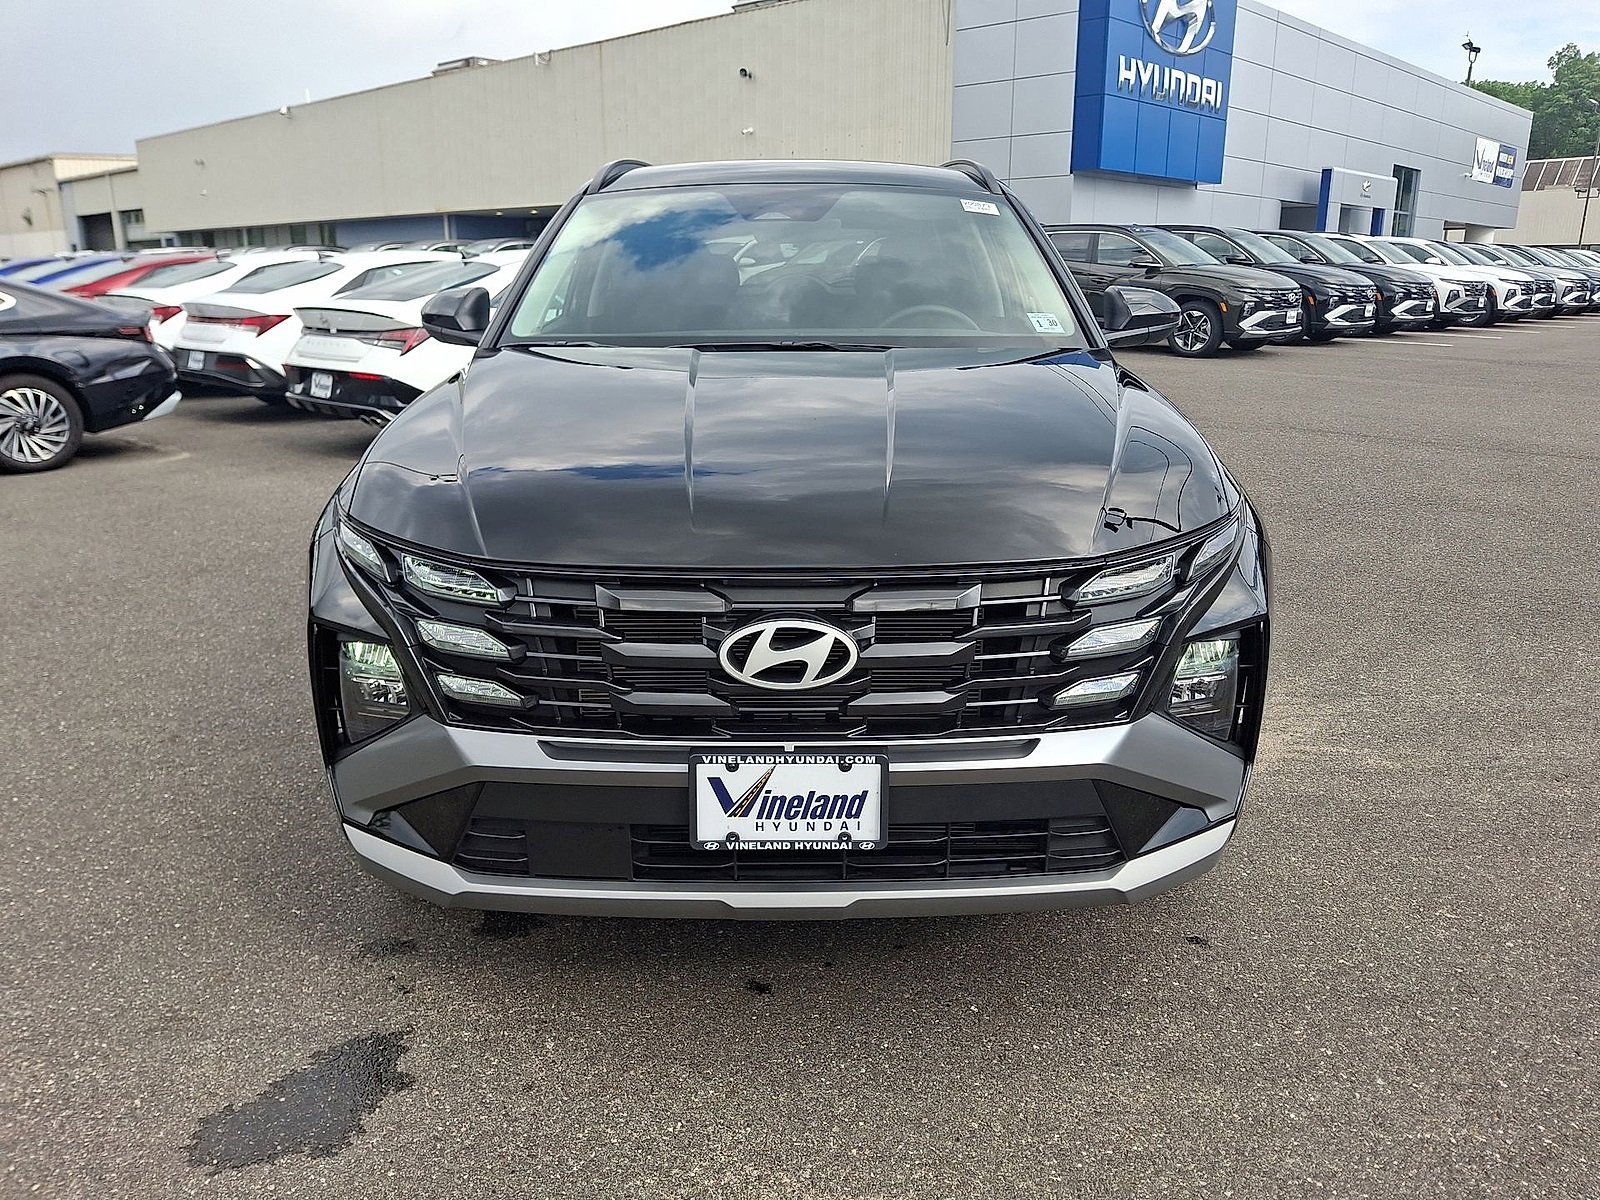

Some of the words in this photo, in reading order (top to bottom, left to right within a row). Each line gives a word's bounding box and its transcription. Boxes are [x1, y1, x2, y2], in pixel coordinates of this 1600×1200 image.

[1118, 55, 1222, 114] HYUNDAI
[1047, 318, 1058, 327] 30
[702, 755, 876, 764] VINELANDHYUNDAI.COM
[706, 765, 869, 820] Vineland
[755, 821, 861, 832] HYUNDAI
[726, 842, 791, 850] VINELAND
[795, 842, 852, 850] HYUNDAI
